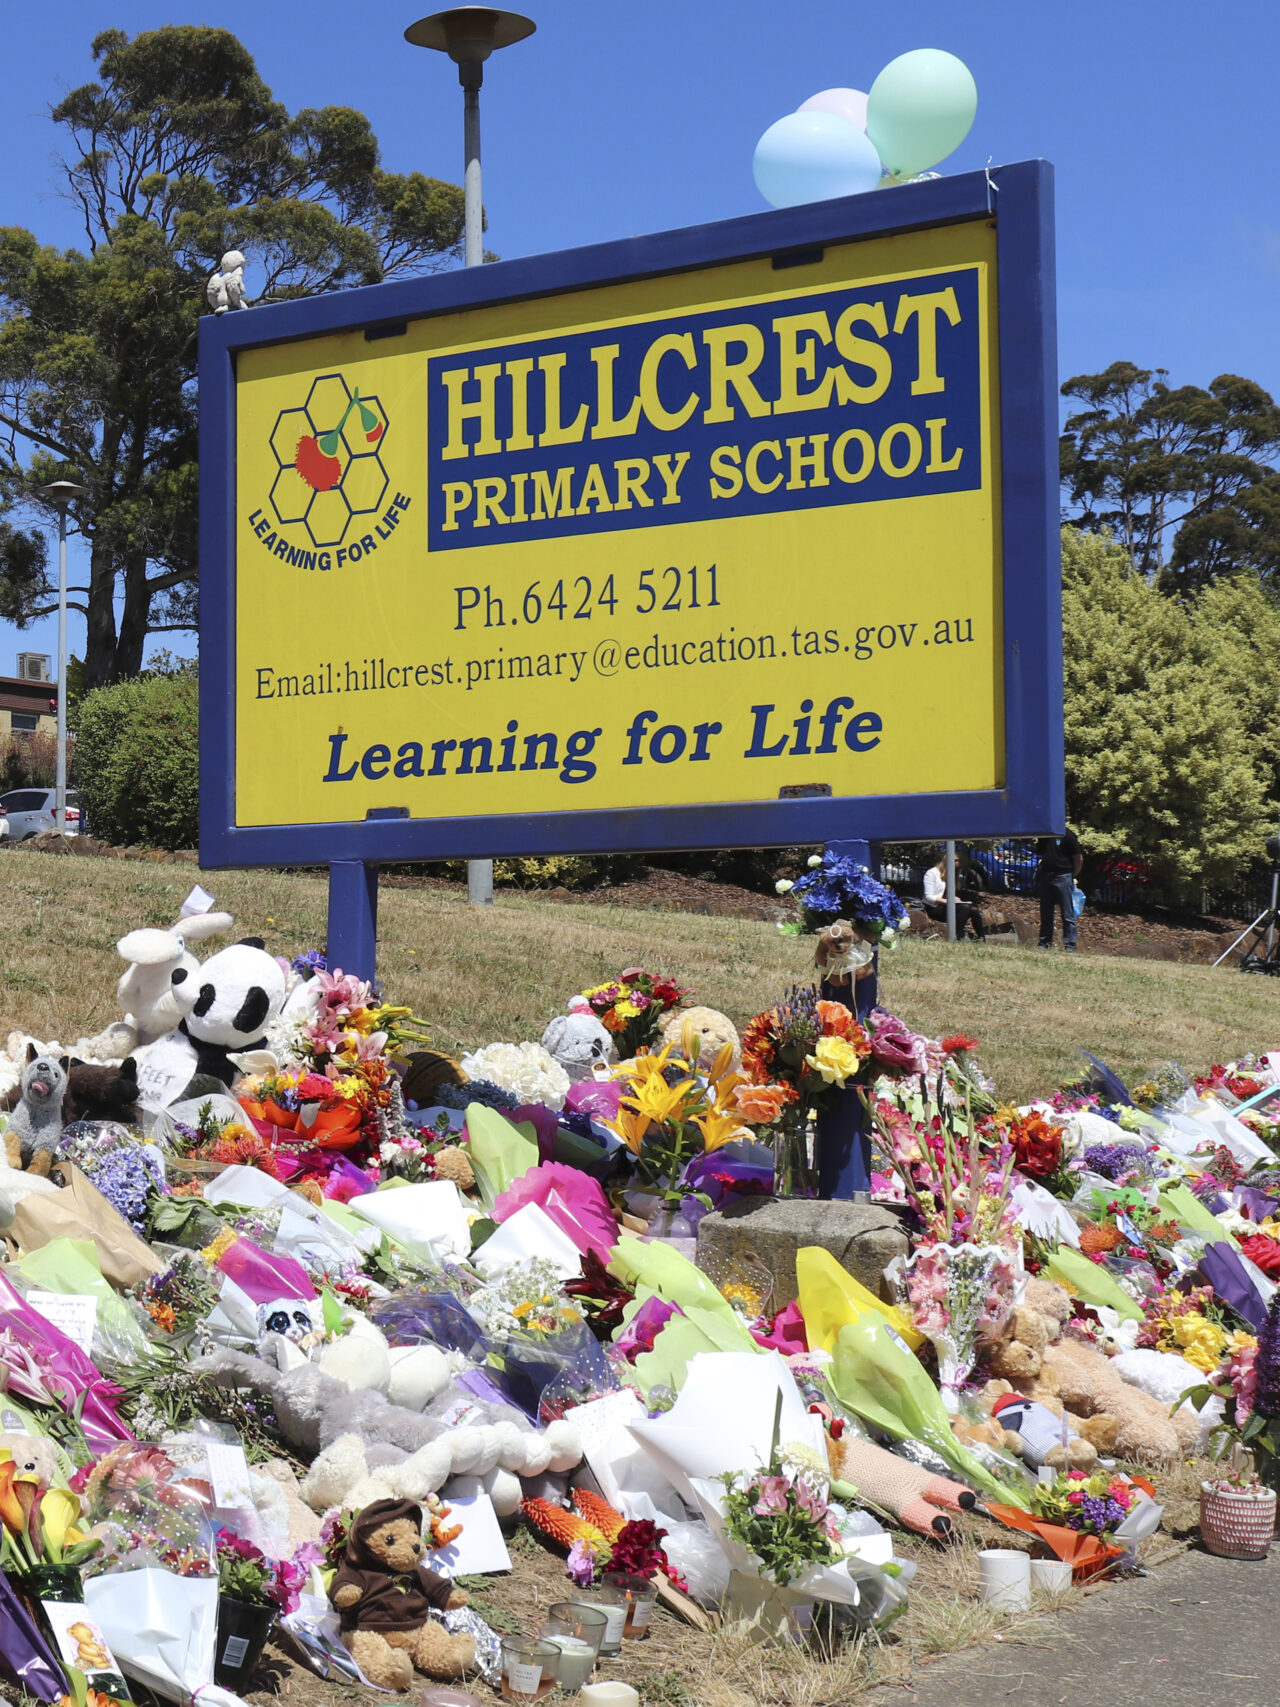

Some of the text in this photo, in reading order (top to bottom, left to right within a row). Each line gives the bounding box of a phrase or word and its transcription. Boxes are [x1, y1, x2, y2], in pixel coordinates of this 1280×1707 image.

[440, 286, 963, 461] HILLCREST
[441, 417, 964, 532] PRIMARY SCHOOL
[247, 492, 412, 572] LEARNING FOR LIFE
[453, 563, 721, 630] Ph.6424 5211
[322, 696, 883, 785] Learning for Life
